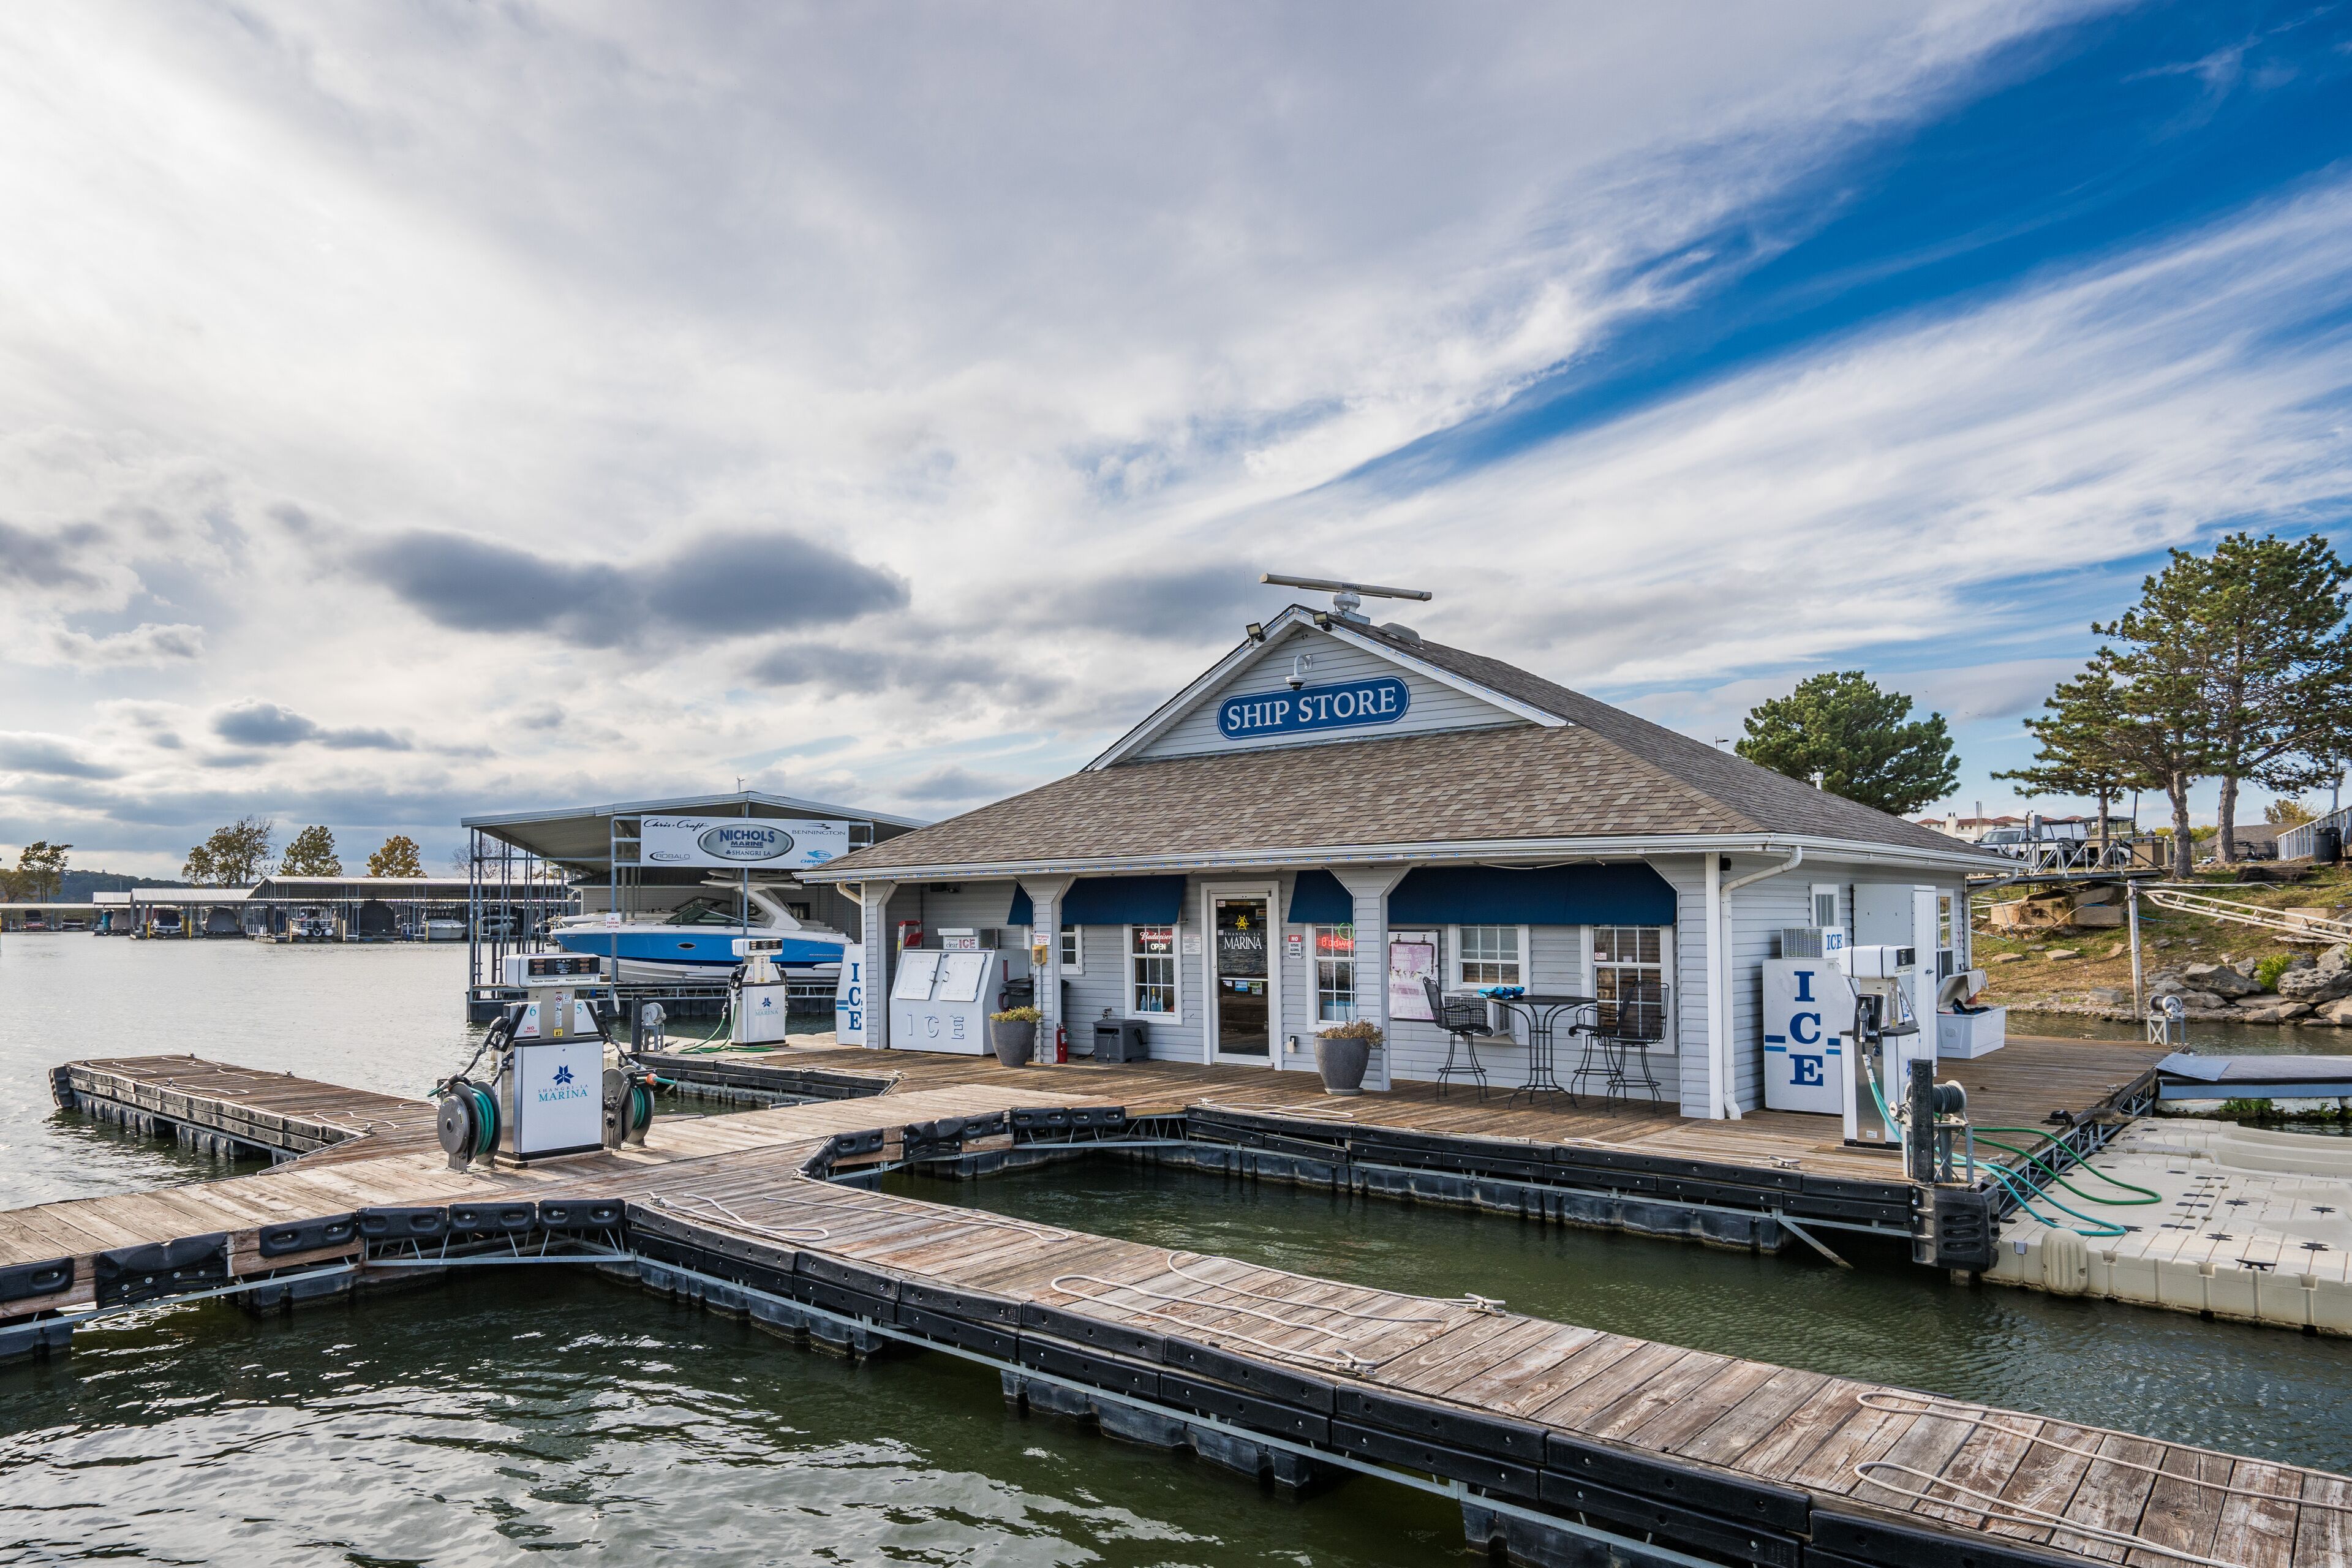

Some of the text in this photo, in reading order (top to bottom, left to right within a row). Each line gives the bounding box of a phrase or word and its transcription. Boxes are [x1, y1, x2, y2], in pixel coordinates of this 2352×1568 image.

[1227, 686, 1398, 731] SHIP STORE
[720, 830, 775, 843] NICHOLS
[959, 939, 976, 949] ICE
[1140, 932, 1172, 944] Budweiser
[1224, 937, 1262, 950] MARINA
[1826, 934, 1842, 950] ICE
[848, 963, 862, 1030] ICE
[529, 1006, 537, 1017] 6
[576, 1004, 582, 1014] 5
[907, 1014, 964, 1039] ICE
[1789, 971, 1823, 1087] ICE
[539, 1089, 588, 1102] MARINA
